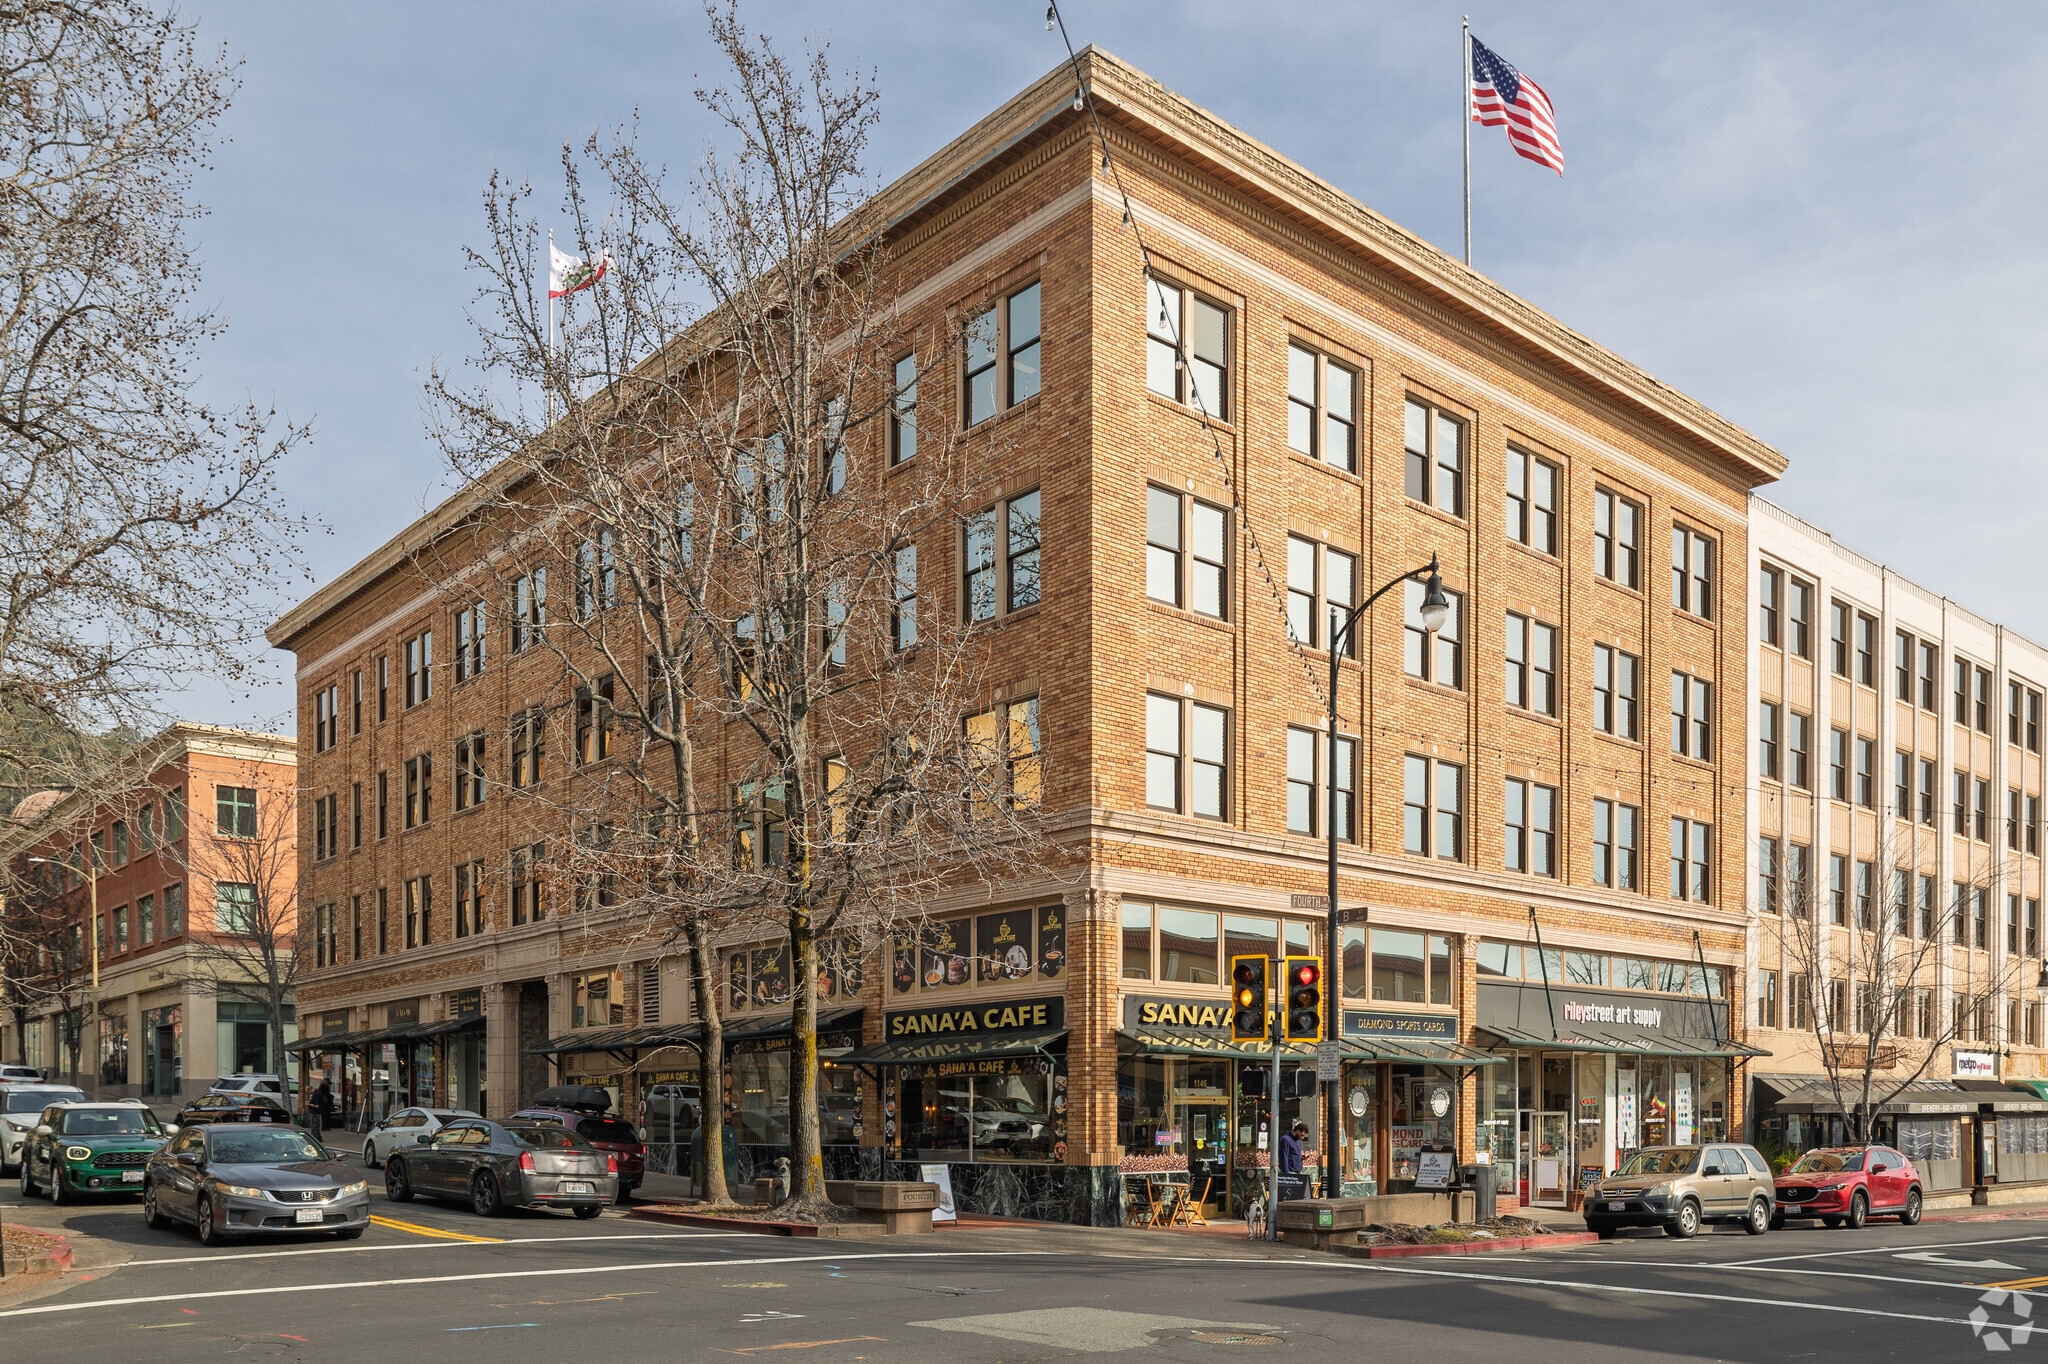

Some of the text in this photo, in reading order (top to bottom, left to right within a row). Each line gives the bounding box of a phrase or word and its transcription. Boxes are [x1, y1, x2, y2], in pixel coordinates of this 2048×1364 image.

[1293, 895, 1320, 908] FOURTH
[1343, 911, 1350, 922] B
[892, 1004, 1047, 1035] SANA'A CAFE
[1616, 1006, 1631, 1024] art
[1633, 1007, 1662, 1029] supply
[1357, 1018, 1445, 1032] DIAMOND SPORTS CARDS
[939, 1060, 1004, 1076] SANA'A CAFE
[1959, 1057, 1977, 1070] metro
[676, 1071, 689, 1083] CAFE
[1580, 1097, 1597, 1105] OPEN
[903, 1193, 933, 1201] FOURTH
